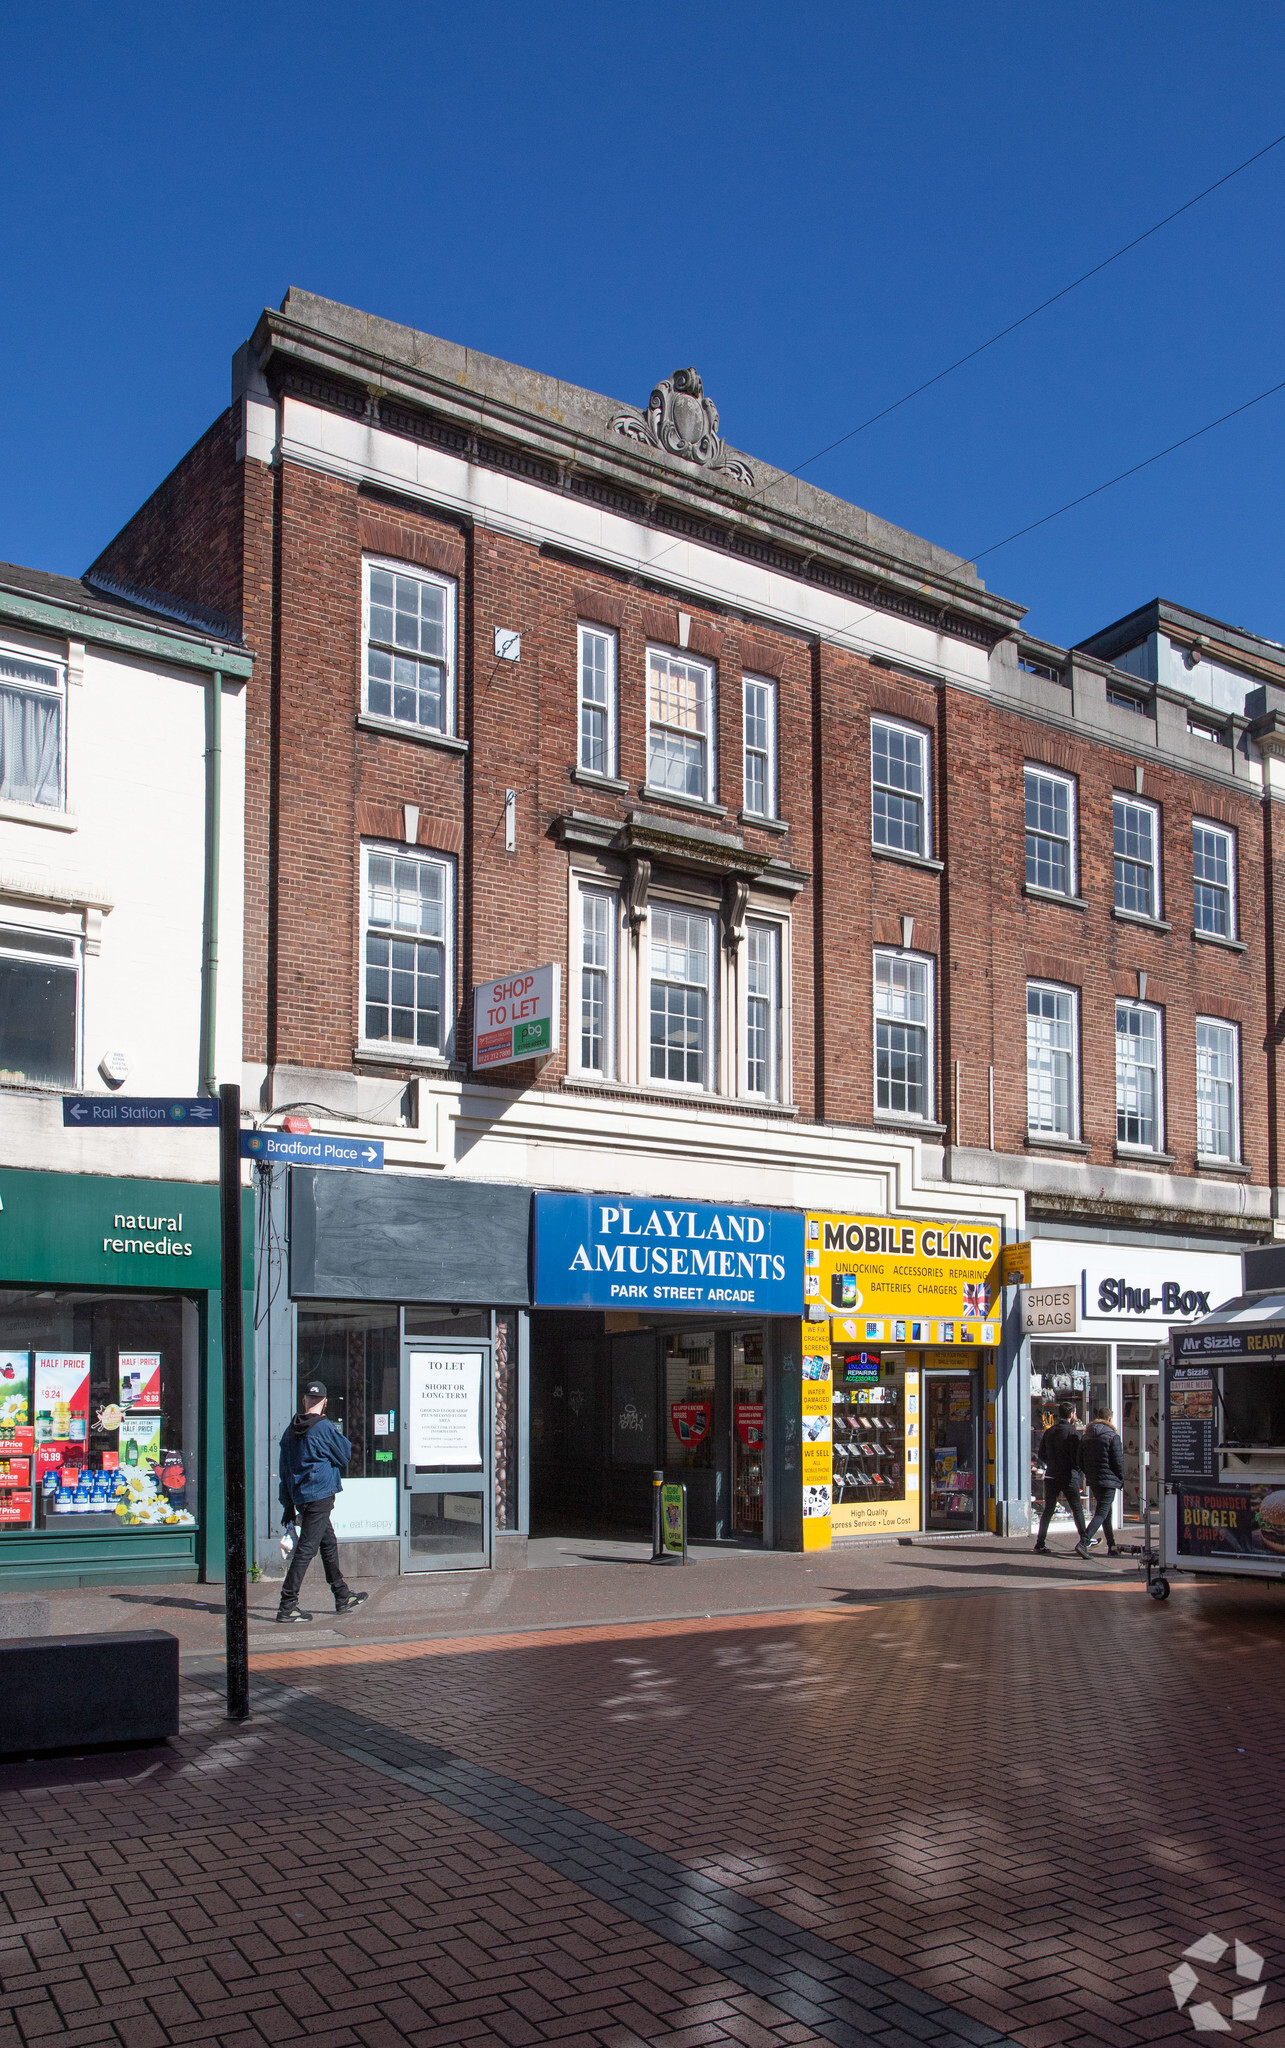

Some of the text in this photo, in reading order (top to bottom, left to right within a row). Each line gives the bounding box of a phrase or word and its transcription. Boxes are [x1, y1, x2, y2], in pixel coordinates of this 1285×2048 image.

[493, 976, 534, 1003] SHOP
[487, 997, 540, 1026] TO LET
[521, 1024, 542, 1042] pbg
[93, 1106, 166, 1120] Rail Station
[267, 1140, 358, 1160] Bradford Place
[114, 1213, 182, 1231] natural
[599, 1206, 765, 1243] PLAYLAND
[103, 1236, 192, 1256] remedies
[823, 1222, 994, 1262] MOBILE CLINIC
[568, 1243, 786, 1281] AMUSEMENTS
[836, 1263, 988, 1280] UNLOCKING ACCESSORIES REPAIRING
[611, 1284, 755, 1302] PARK STREET ARCADE
[870, 1282, 958, 1295] BATTERIES CHARGERS
[1028, 1293, 1070, 1307] SHOES
[1098, 1277, 1211, 1316] Shu-Box
[1026, 1312, 1072, 1326] & BAGS
[1182, 1336, 1241, 1350] Mr Sizzle
[1247, 1334, 1284, 1350] READY
[40, 1359, 85, 1368] HALF PRICE
[122, 1358, 157, 1366] HALF PRICE
[428, 1362, 465, 1370] TO LET
[1174, 1368, 1209, 1377] Mr Sizzle
[1171, 1380, 1212, 1390] DAYTIME MENU
[40, 1452, 60, 1462] £9.99
[1183, 1496, 1247, 1510] QTR POUNDER
[850, 1508, 888, 1518] High Quality
[1184, 1508, 1238, 1528] BURGER
[350, 1520, 393, 1530] eat happy
[831, 1522, 852, 1530] xpress
[854, 1520, 876, 1528] Service
[882, 1518, 895, 1526] Low
[1184, 1526, 1225, 1541] & CHIPS
